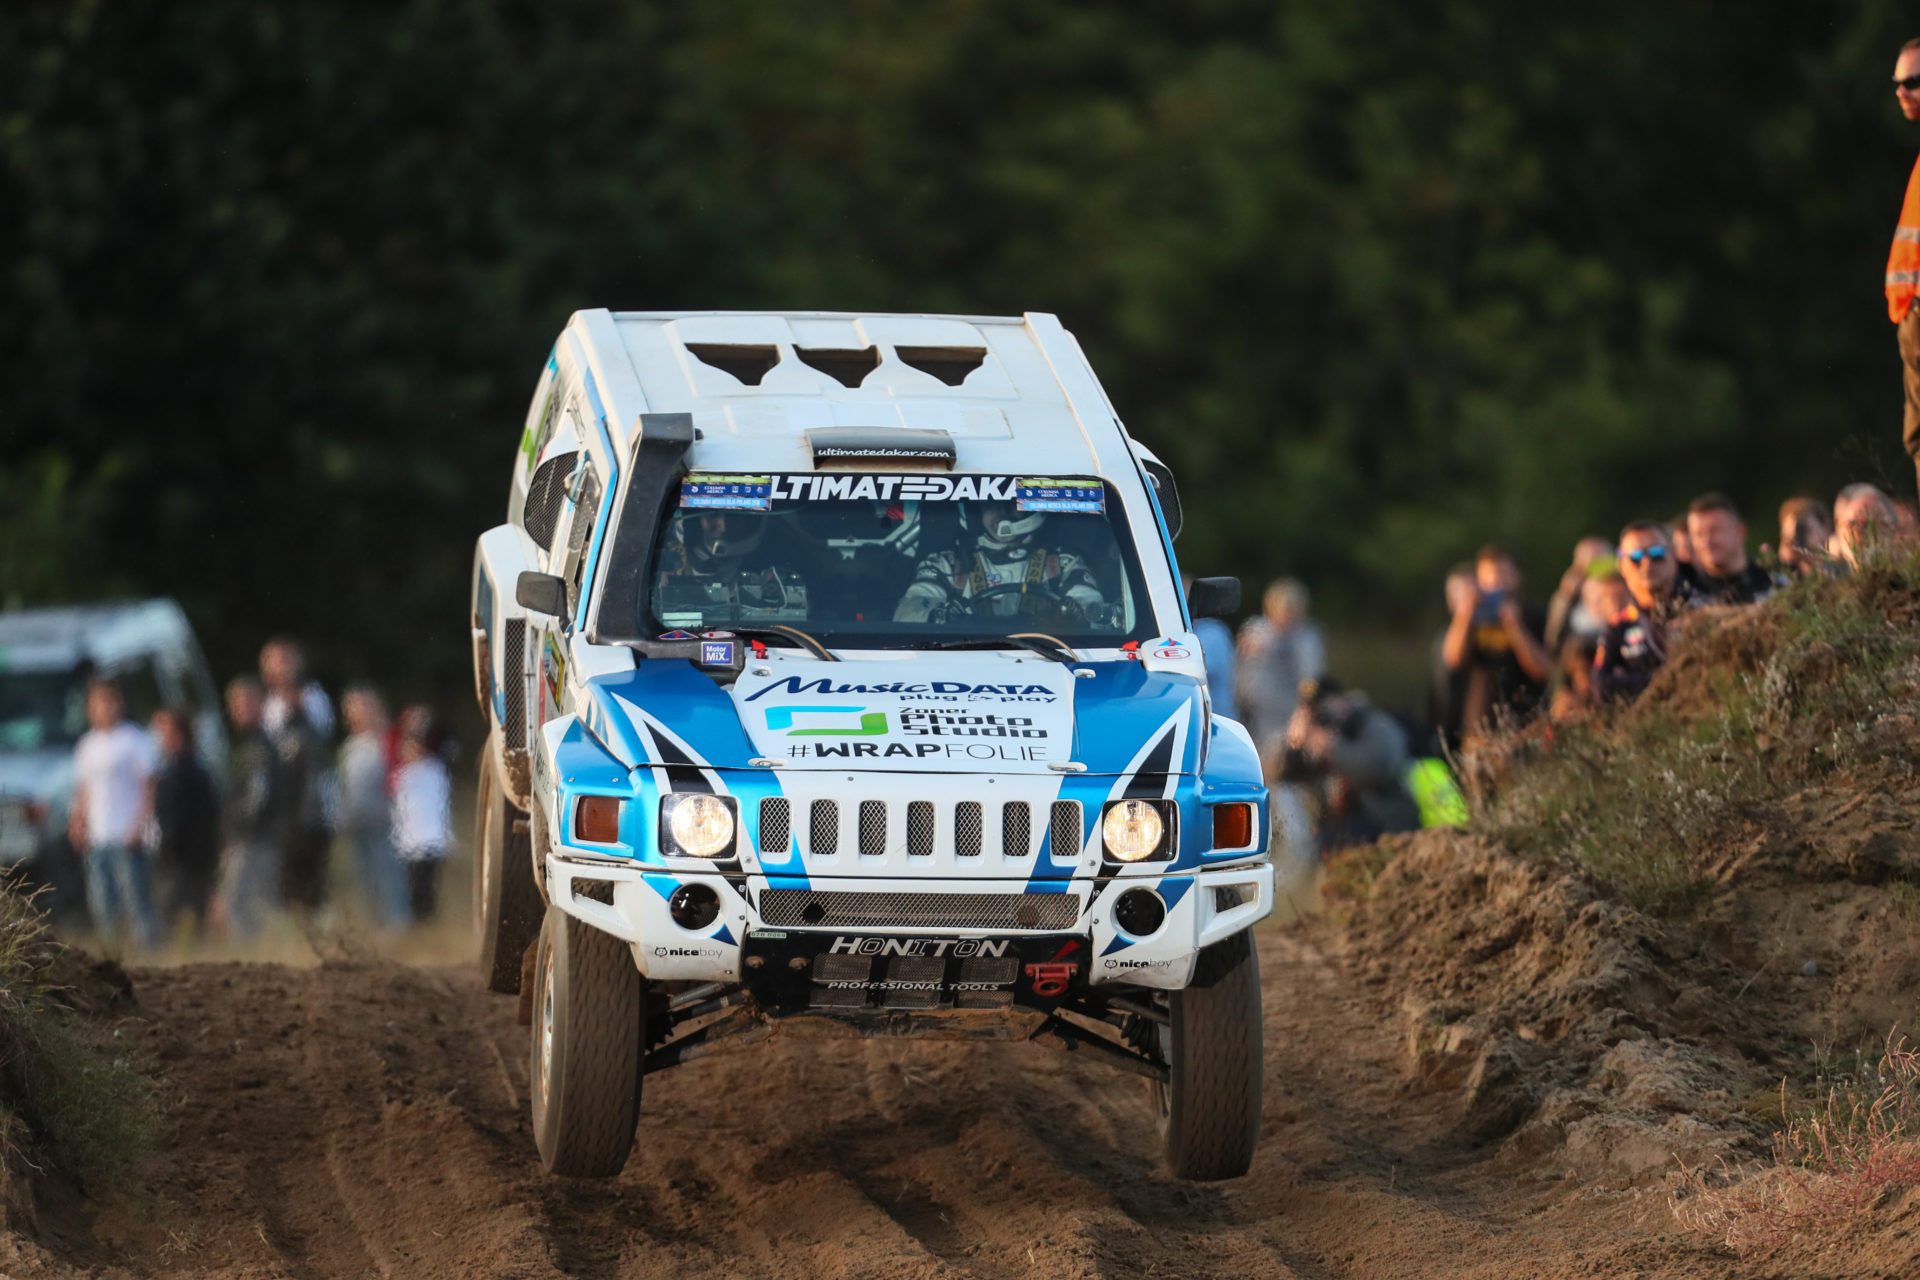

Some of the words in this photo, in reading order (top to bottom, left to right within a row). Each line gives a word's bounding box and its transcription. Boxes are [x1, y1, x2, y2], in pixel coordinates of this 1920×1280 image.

[817, 447, 949, 458] ultimatedakar.com
[706, 652, 726, 661] MiX
[899, 693, 958, 701] plug
[1000, 695, 1058, 703] play
[899, 706, 970, 714] Zoner
[900, 714, 1033, 726] Photo
[902, 725, 1049, 738] Studio
[787, 742, 1049, 761] #WRAPFOLIE
[669, 947, 723, 958] niceboy
[828, 936, 1010, 958] HONITON
[1119, 957, 1174, 969] niceboy
[828, 981, 944, 991] PROFESSIONAL
[948, 982, 999, 992] TOOLS
